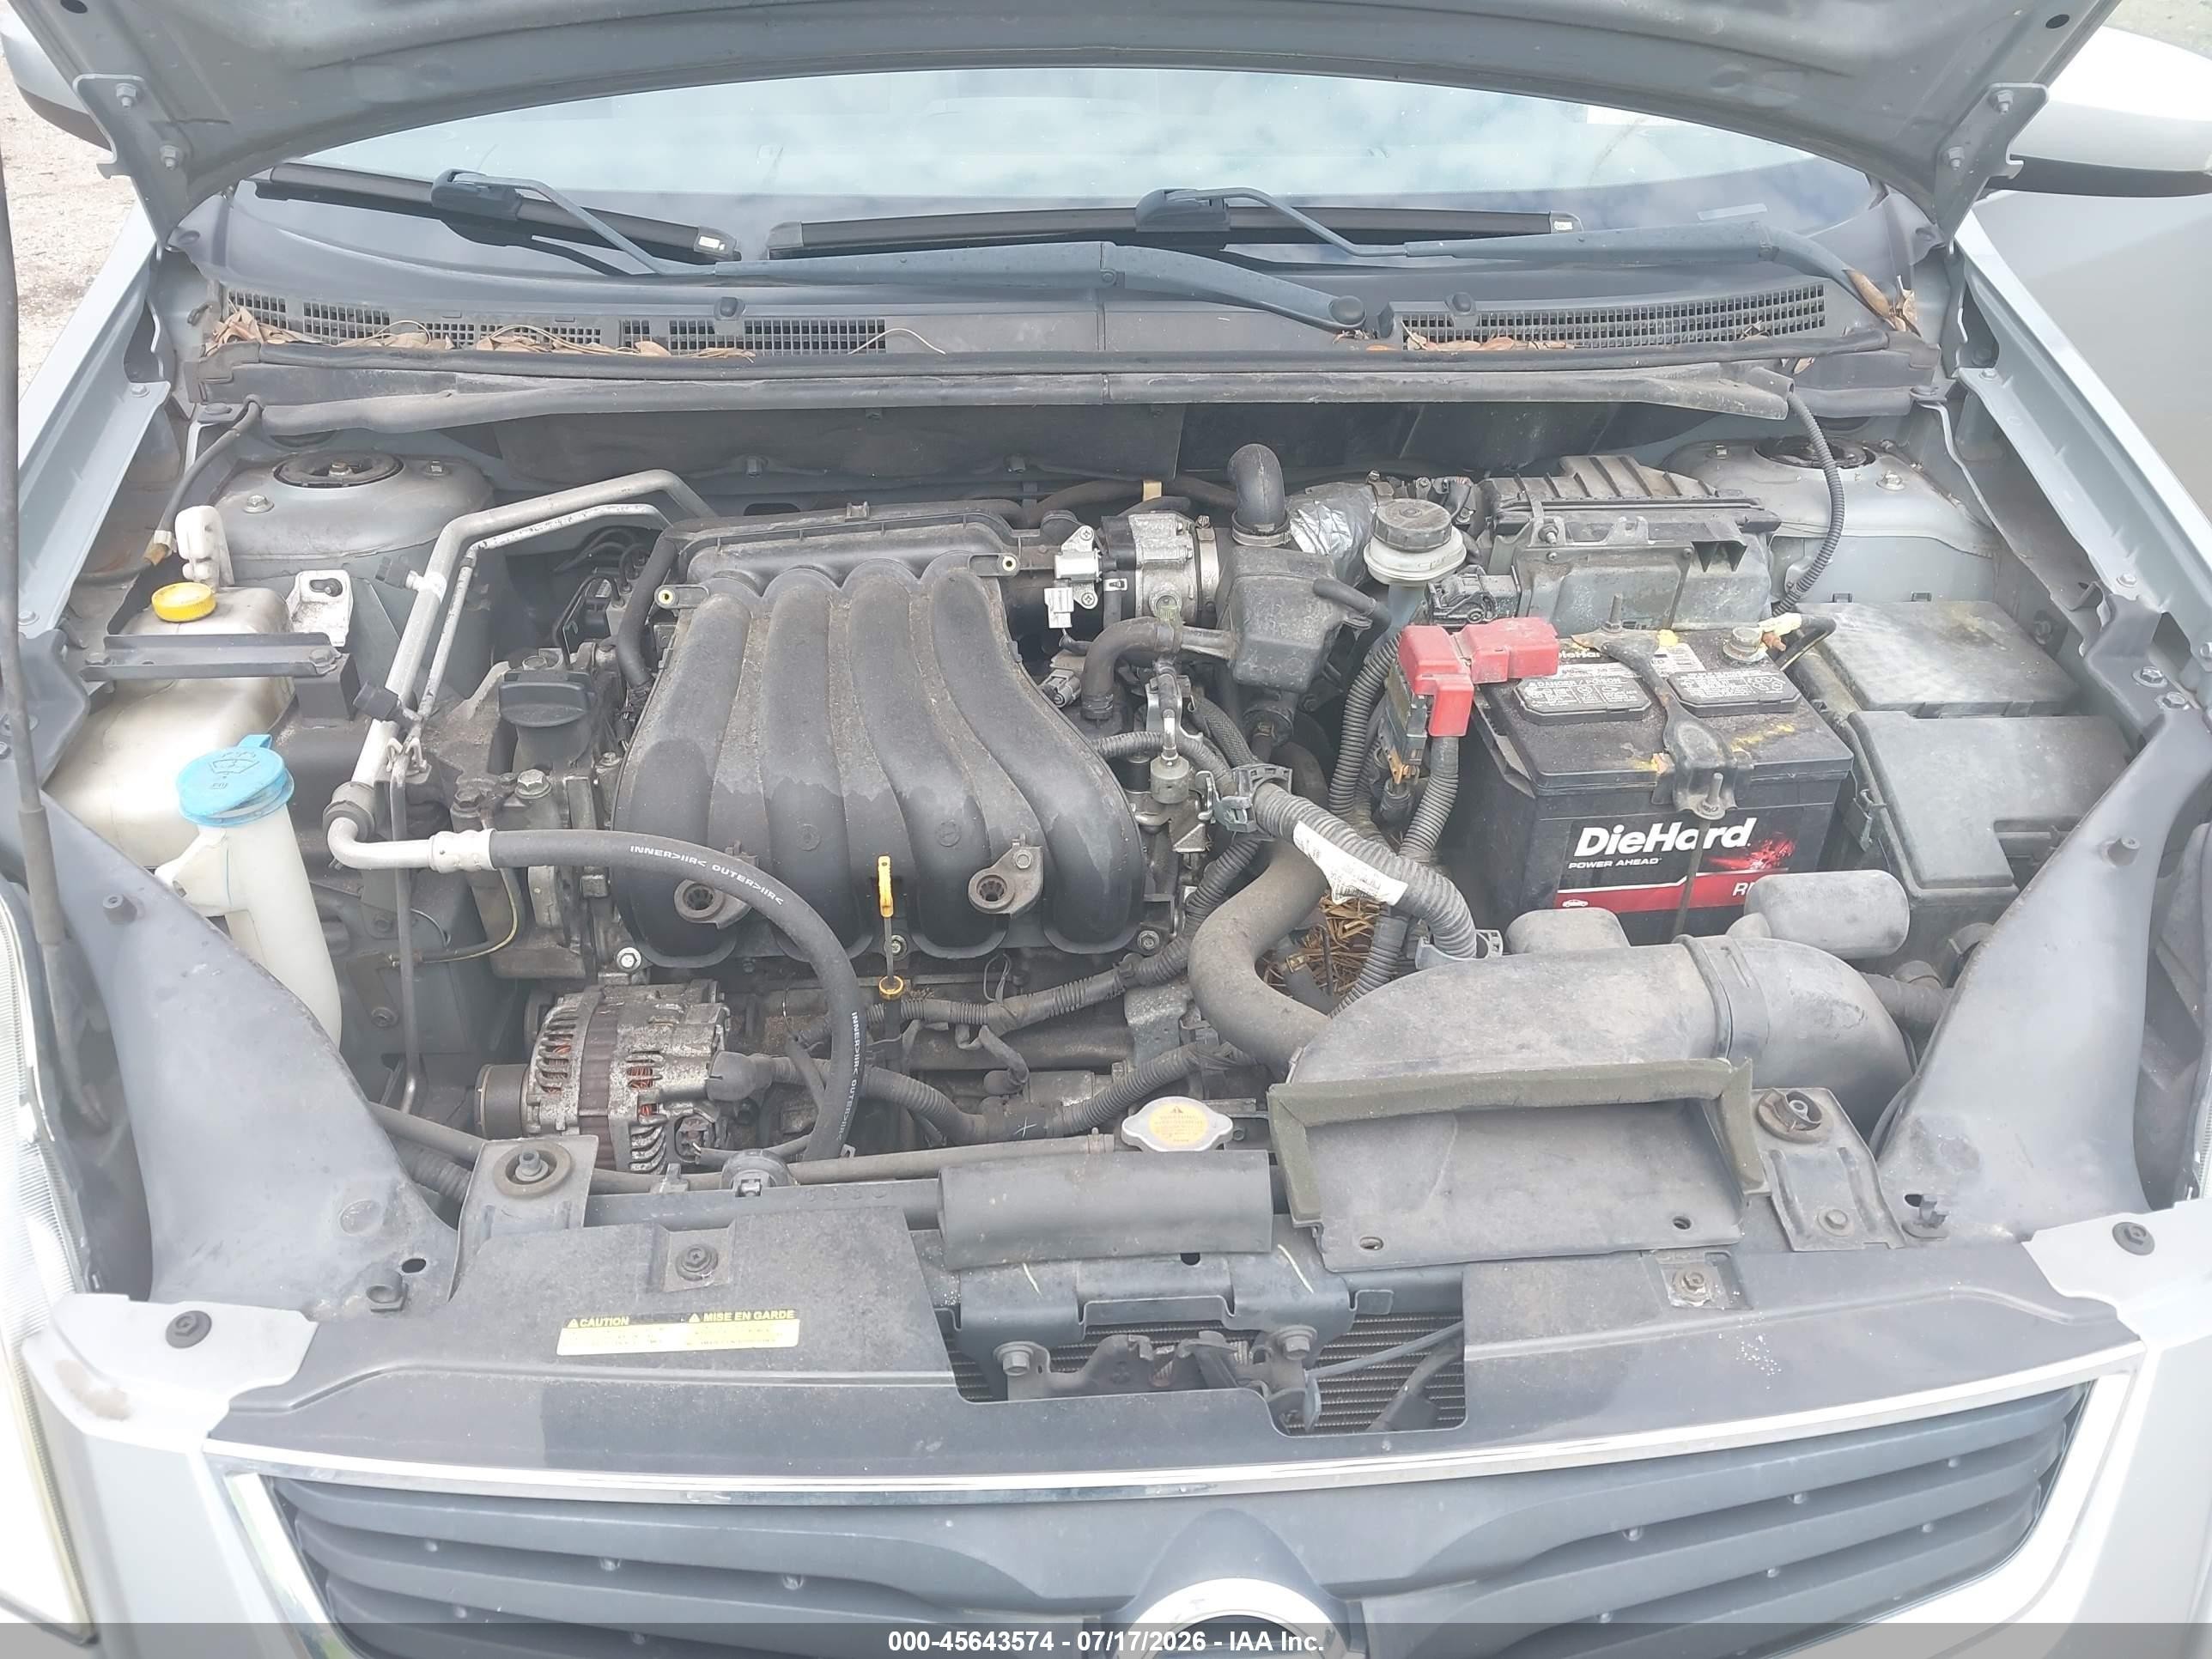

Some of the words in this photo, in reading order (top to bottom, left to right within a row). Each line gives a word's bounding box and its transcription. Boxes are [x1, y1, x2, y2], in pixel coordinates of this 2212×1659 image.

[1574, 817, 1757, 857] DieHard
[1568, 860, 1613, 869] POWER
[1615, 858, 1659, 866] AHEAD
[580, 1316, 629, 1328] CAUTION
[703, 1312, 732, 1322] MISE
[734, 1311, 751, 1321] EN
[753, 1310, 795, 1320] GARDE
